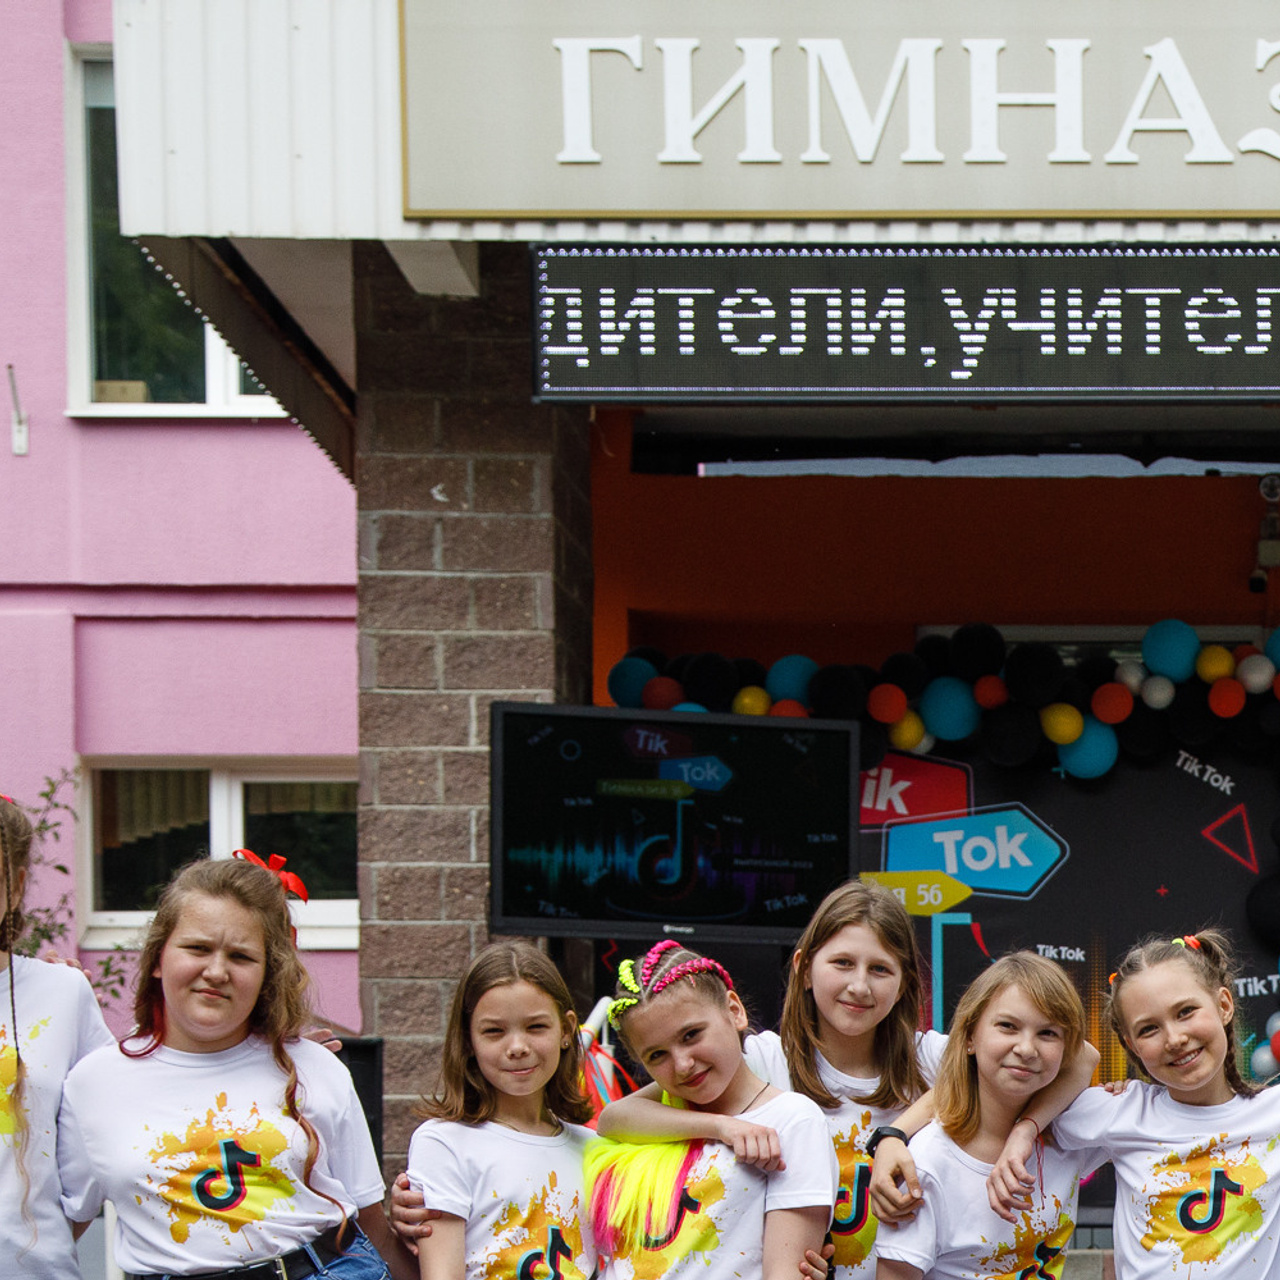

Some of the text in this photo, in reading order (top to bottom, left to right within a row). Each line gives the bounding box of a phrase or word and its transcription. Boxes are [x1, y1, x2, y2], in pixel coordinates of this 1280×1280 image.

[636, 729, 669, 755] Tik
[678, 761, 720, 784] Tok
[861, 767, 912, 815] ik
[933, 825, 1033, 875] Tok
[917, 884, 943, 906] 56
